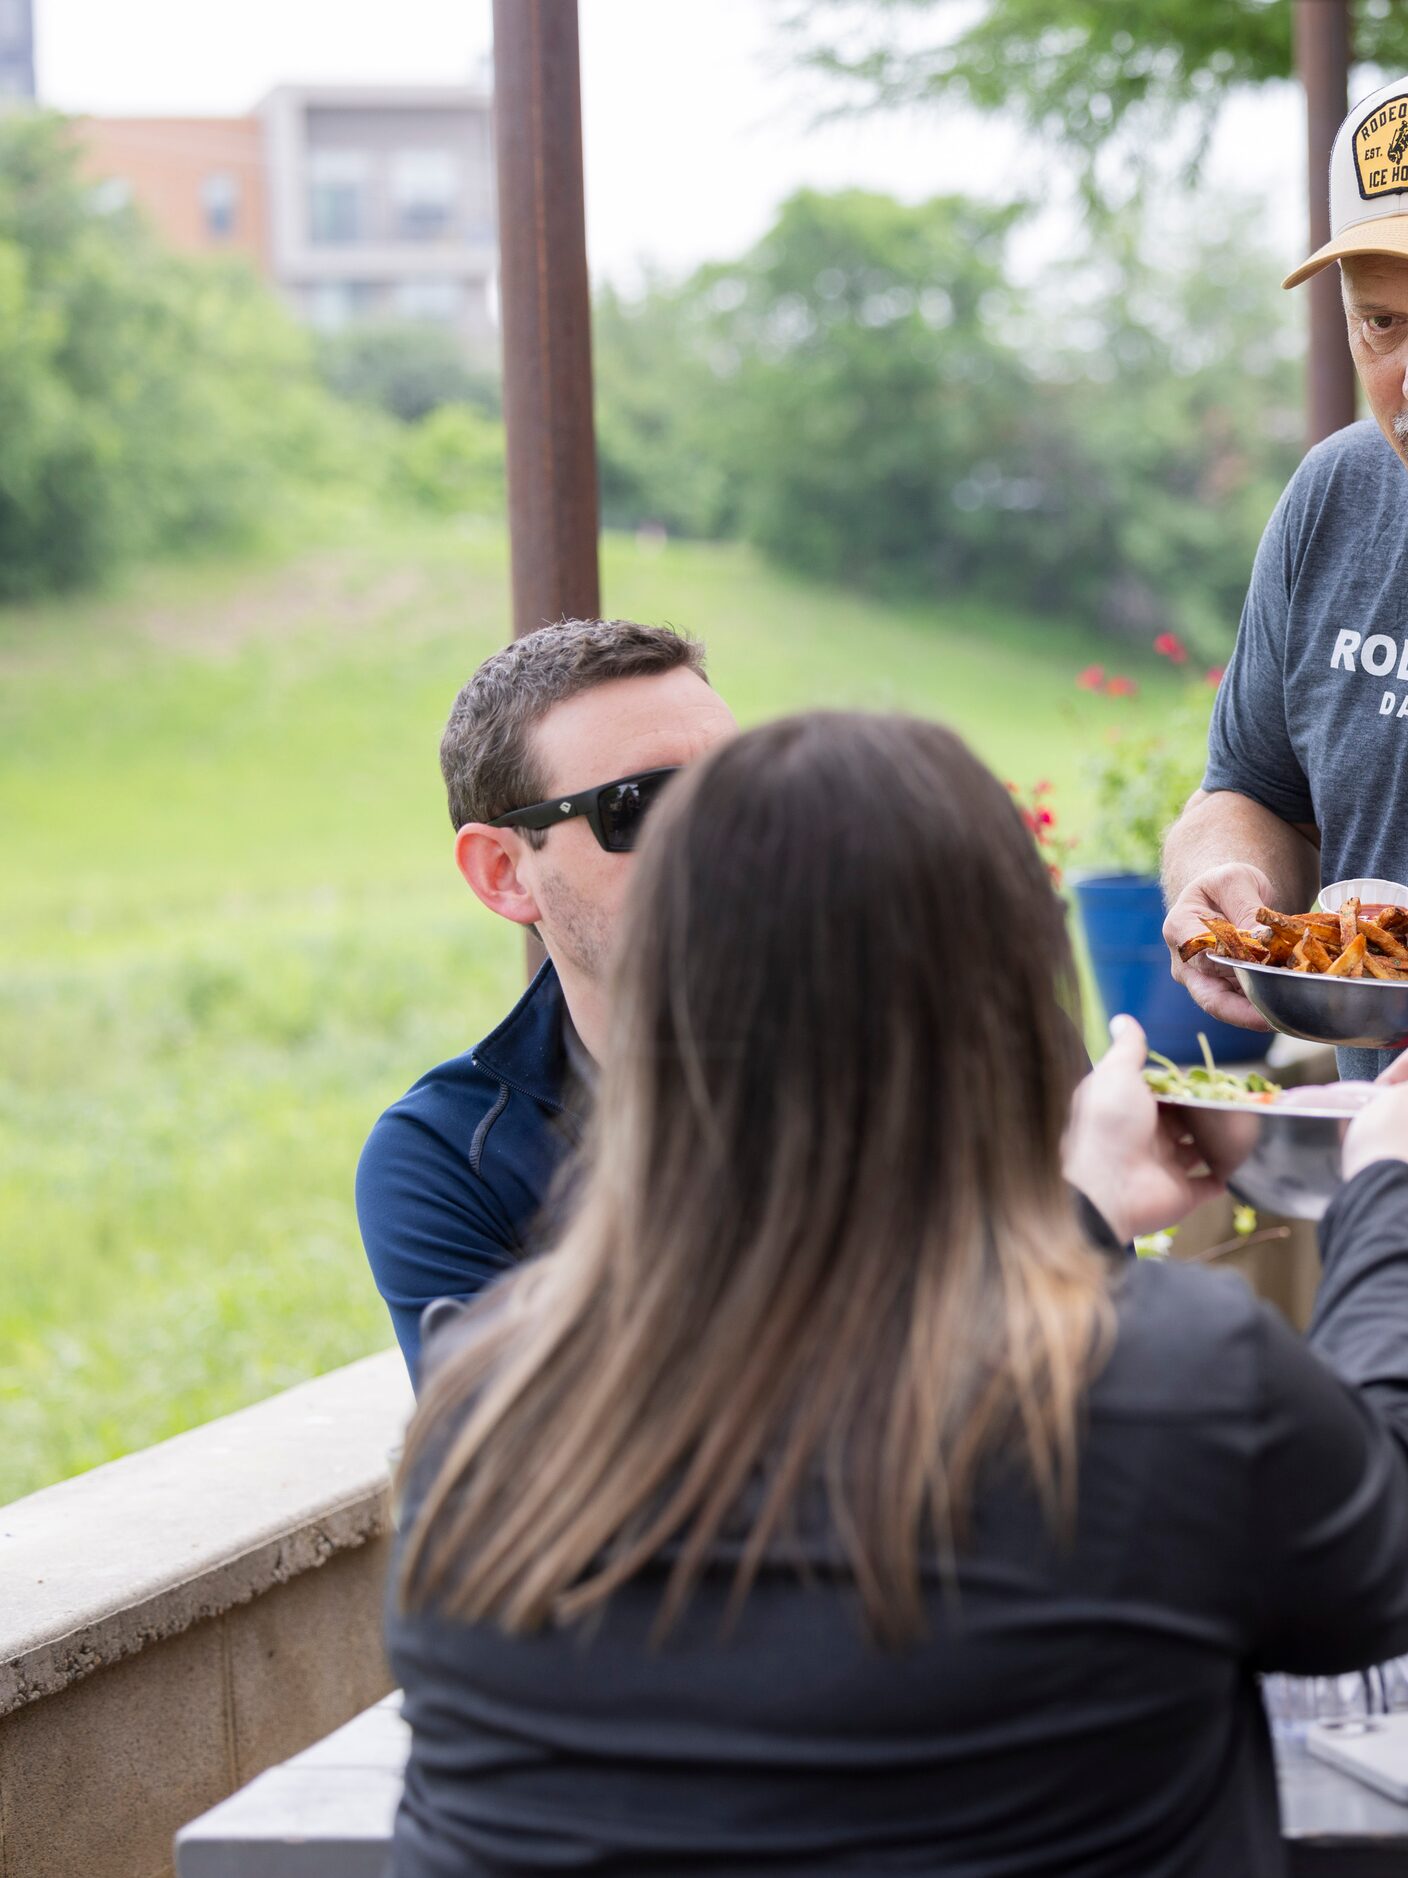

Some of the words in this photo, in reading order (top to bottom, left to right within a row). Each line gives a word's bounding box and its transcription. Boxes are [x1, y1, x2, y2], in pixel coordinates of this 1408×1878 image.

[1361, 103, 1407, 141] RODEO
[1364, 147, 1383, 160] EST.
[1369, 169, 1388, 188] ICE
